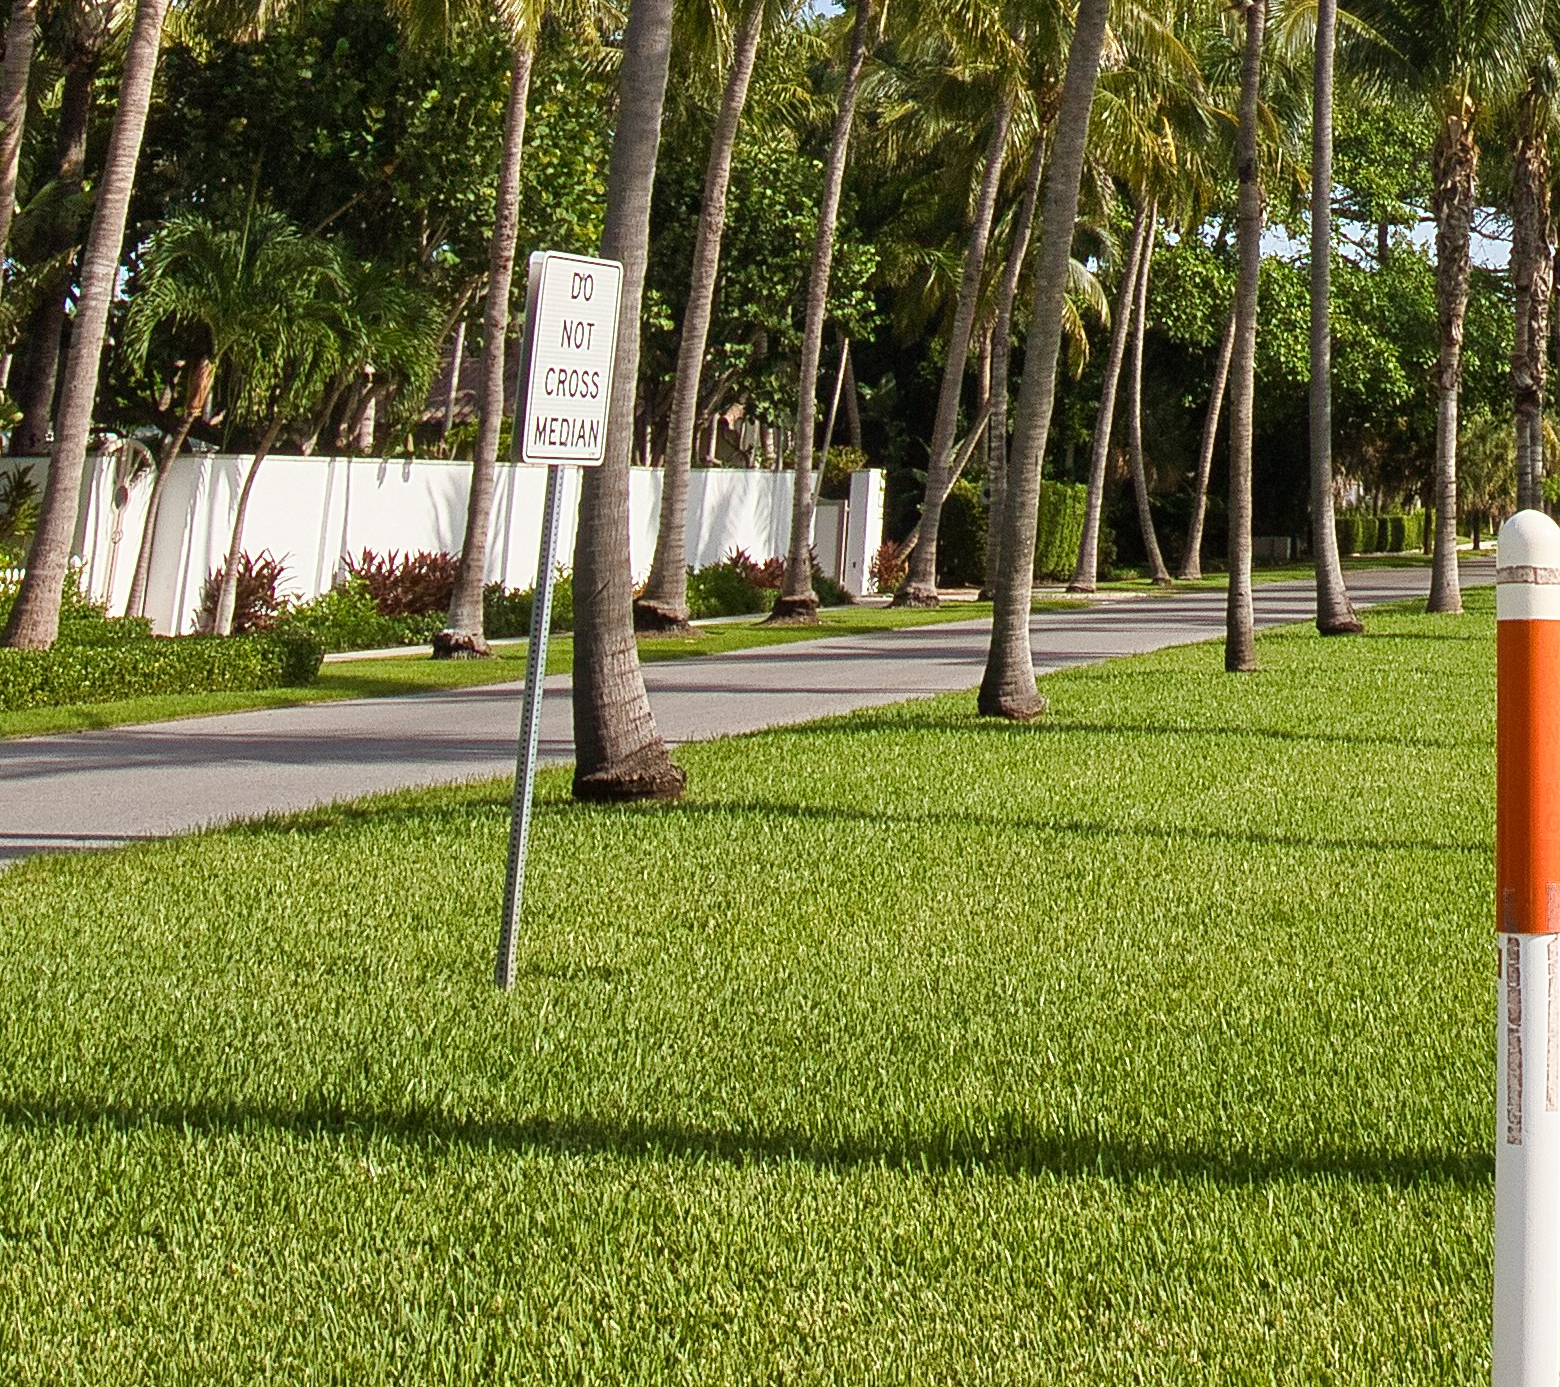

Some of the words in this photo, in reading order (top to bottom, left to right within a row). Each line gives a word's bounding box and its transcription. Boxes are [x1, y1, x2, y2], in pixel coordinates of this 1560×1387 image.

[571, 272, 594, 302] DO
[560, 319, 595, 350] NOT
[544, 367, 600, 399] CROSS
[533, 416, 600, 448] MEDIAN
